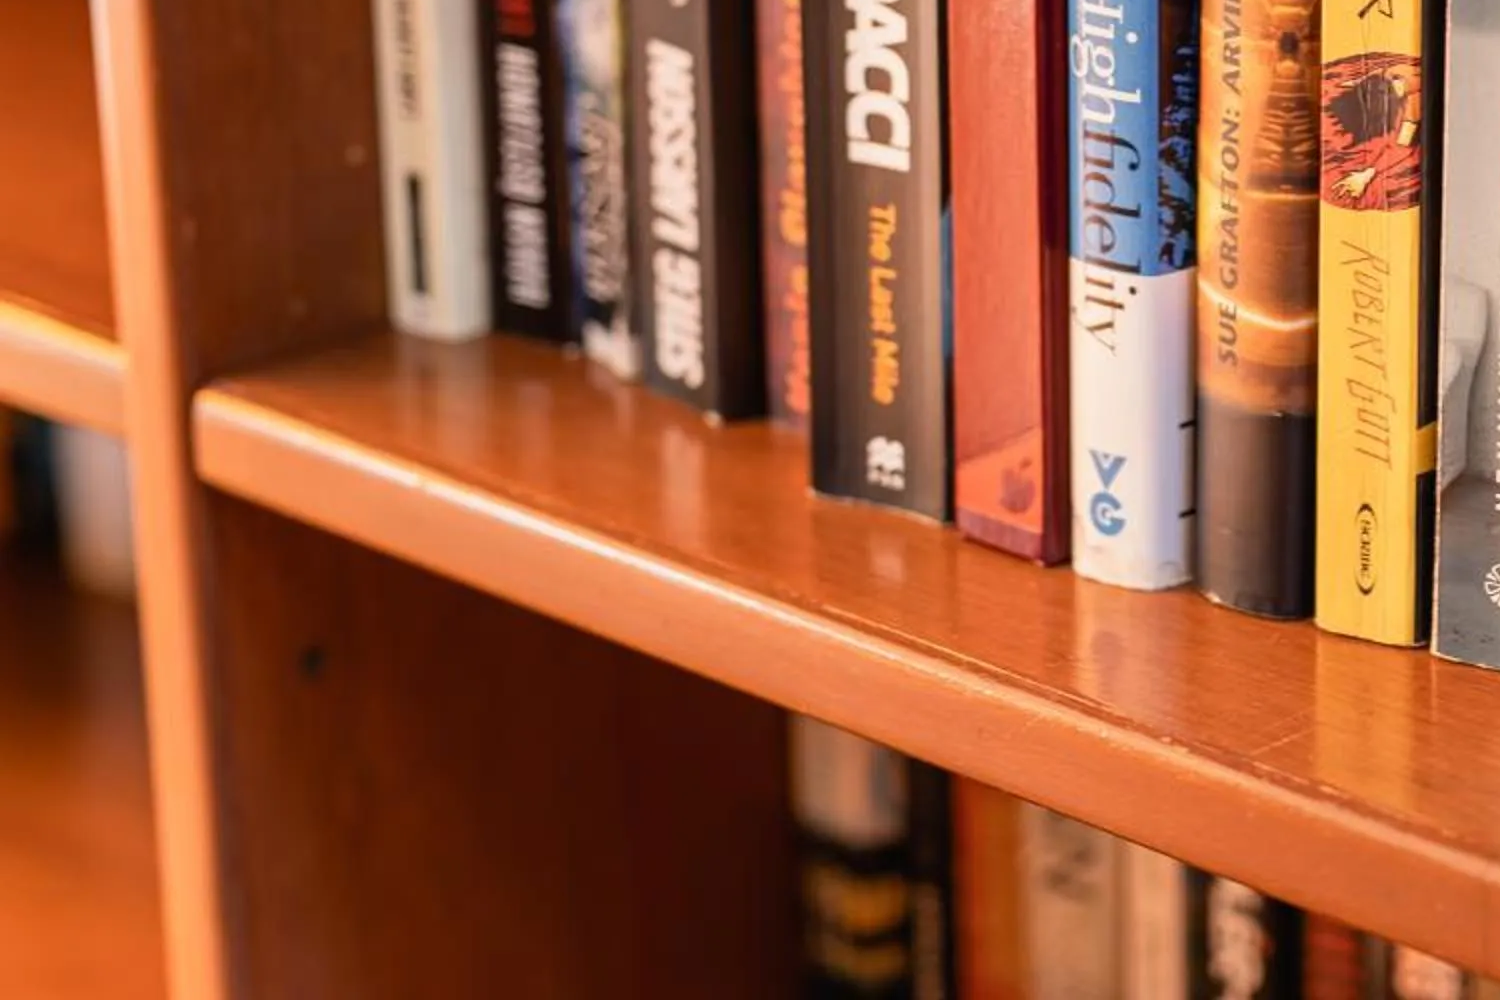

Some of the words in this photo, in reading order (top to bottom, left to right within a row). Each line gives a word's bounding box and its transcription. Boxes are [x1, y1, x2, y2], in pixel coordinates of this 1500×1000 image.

[644, 38, 701, 254] LARSSON
[868, 202, 897, 261] The
[1219, 107, 1243, 286] GRAFTON:
[868, 266, 898, 335] Last
[1217, 302, 1240, 367] SUE
[1340, 239, 1392, 380] ROBERT
[869, 337, 901, 407] Mile
